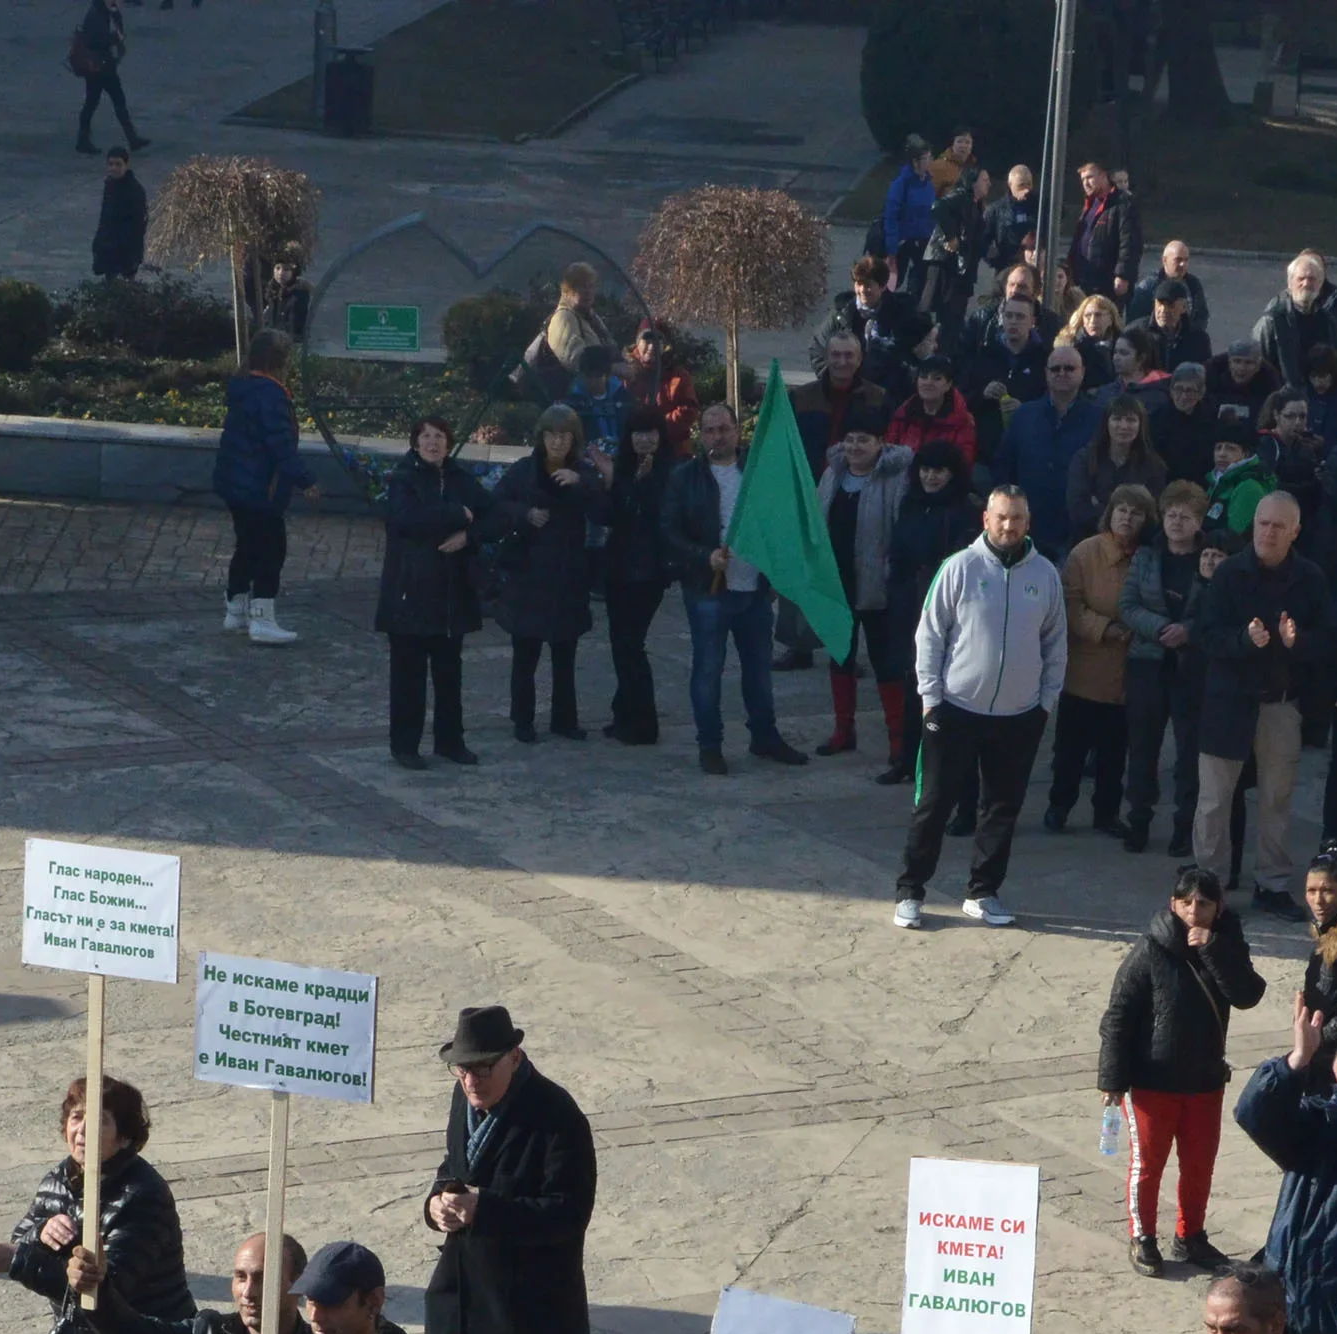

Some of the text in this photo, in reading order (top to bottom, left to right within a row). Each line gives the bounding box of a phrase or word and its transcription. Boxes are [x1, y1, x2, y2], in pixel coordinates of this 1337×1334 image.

[48, 861, 154, 887] Глас народен...
[53, 885, 147, 911] Глас Божии...
[25, 905, 175, 938] Гласът ни е за кмета!
[43, 932, 155, 959] Иван Гавалюгов
[203, 964, 369, 1004] Не искаме крадци
[229, 998, 341, 1029] в Ботевград!
[219, 1023, 350, 1057] Честният кмет
[198, 1051, 367, 1087] е Иван Гавалюгов!
[919, 1211, 1025, 1234] ИСКАМЕ СИ
[937, 1240, 1004, 1260] КМЕТА!
[943, 1268, 995, 1287] ИВАН
[908, 1293, 1026, 1318] ГАВАЛЮГОВ
